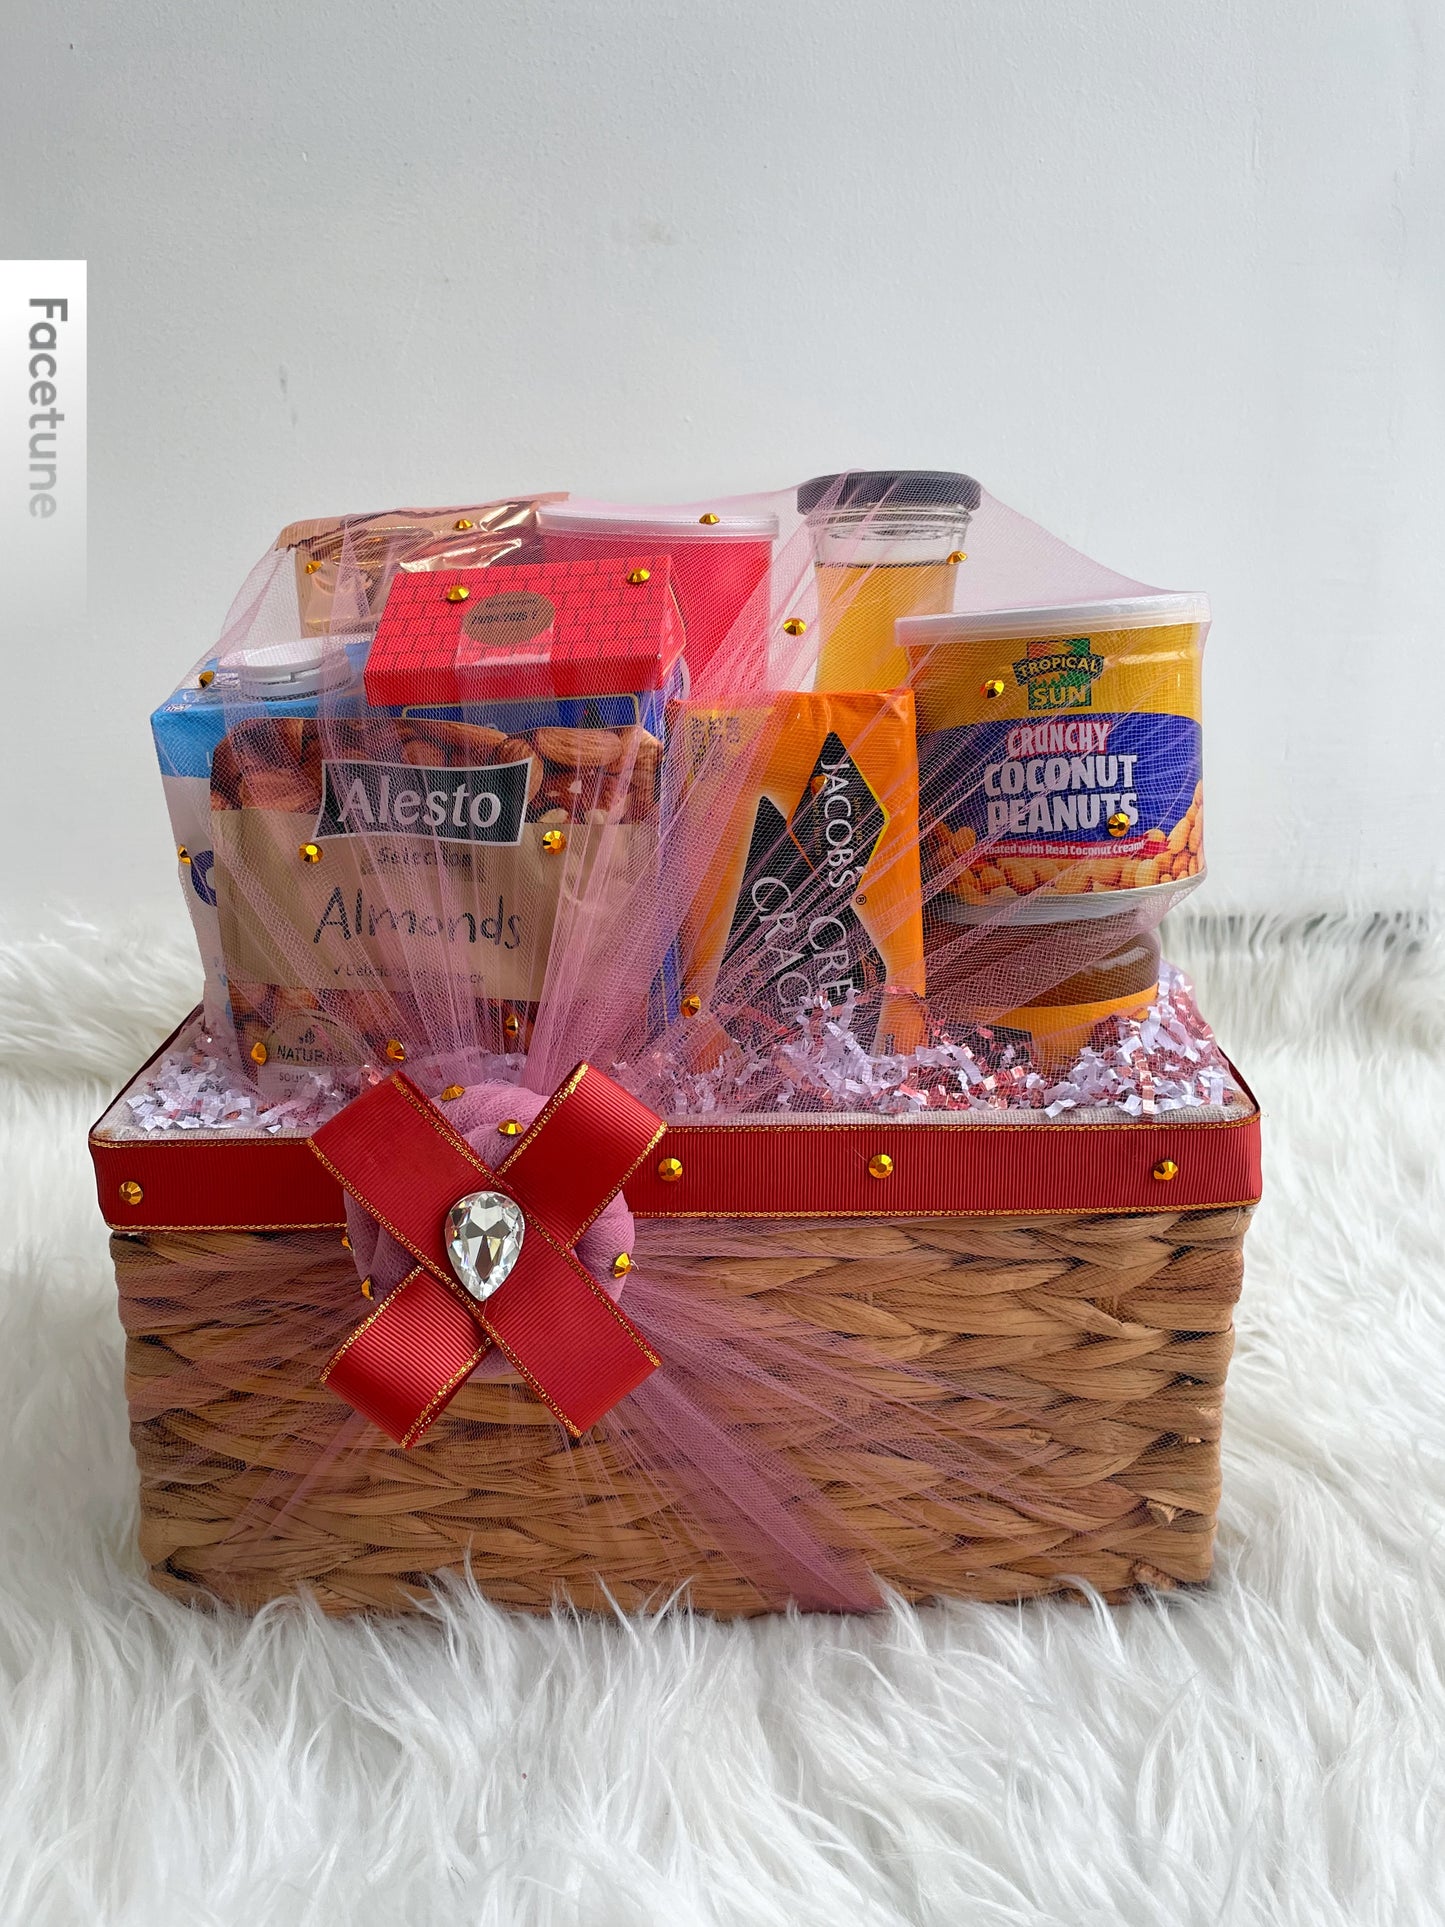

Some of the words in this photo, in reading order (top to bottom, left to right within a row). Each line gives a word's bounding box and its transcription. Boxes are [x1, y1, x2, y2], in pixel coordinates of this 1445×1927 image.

[1020, 656, 1099, 677] TROPICAL
[1033, 685, 1086, 706] SUN
[1007, 721, 1110, 757] CRUNCHY
[984, 755, 1138, 797] COCONUT
[337, 774, 501, 828] Alesto
[987, 793, 1139, 835] PEANUTS
[1018, 844, 1044, 854] with
[1045, 844, 1068, 855] Real
[1070, 845, 1112, 856] Coconut
[313, 886, 521, 950] Almonds
